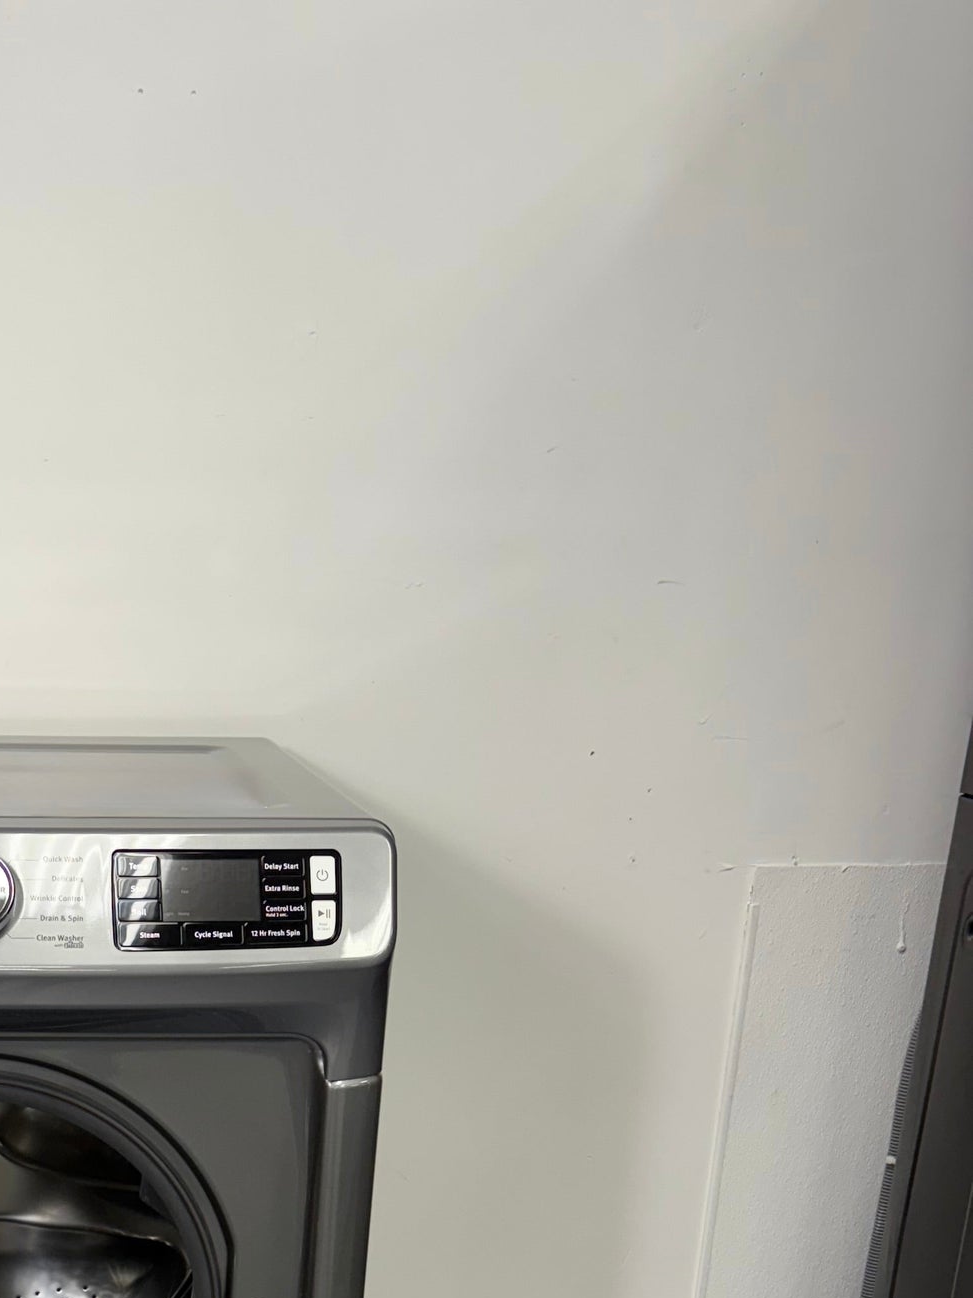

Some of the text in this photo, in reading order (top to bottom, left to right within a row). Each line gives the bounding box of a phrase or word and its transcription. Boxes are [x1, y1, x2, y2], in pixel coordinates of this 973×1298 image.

[264, 863, 282, 871] Delay
[67, 914, 84, 923] Spin
[194, 931, 233, 939] Cycle Signal
[286, 929, 301, 937] Spin
